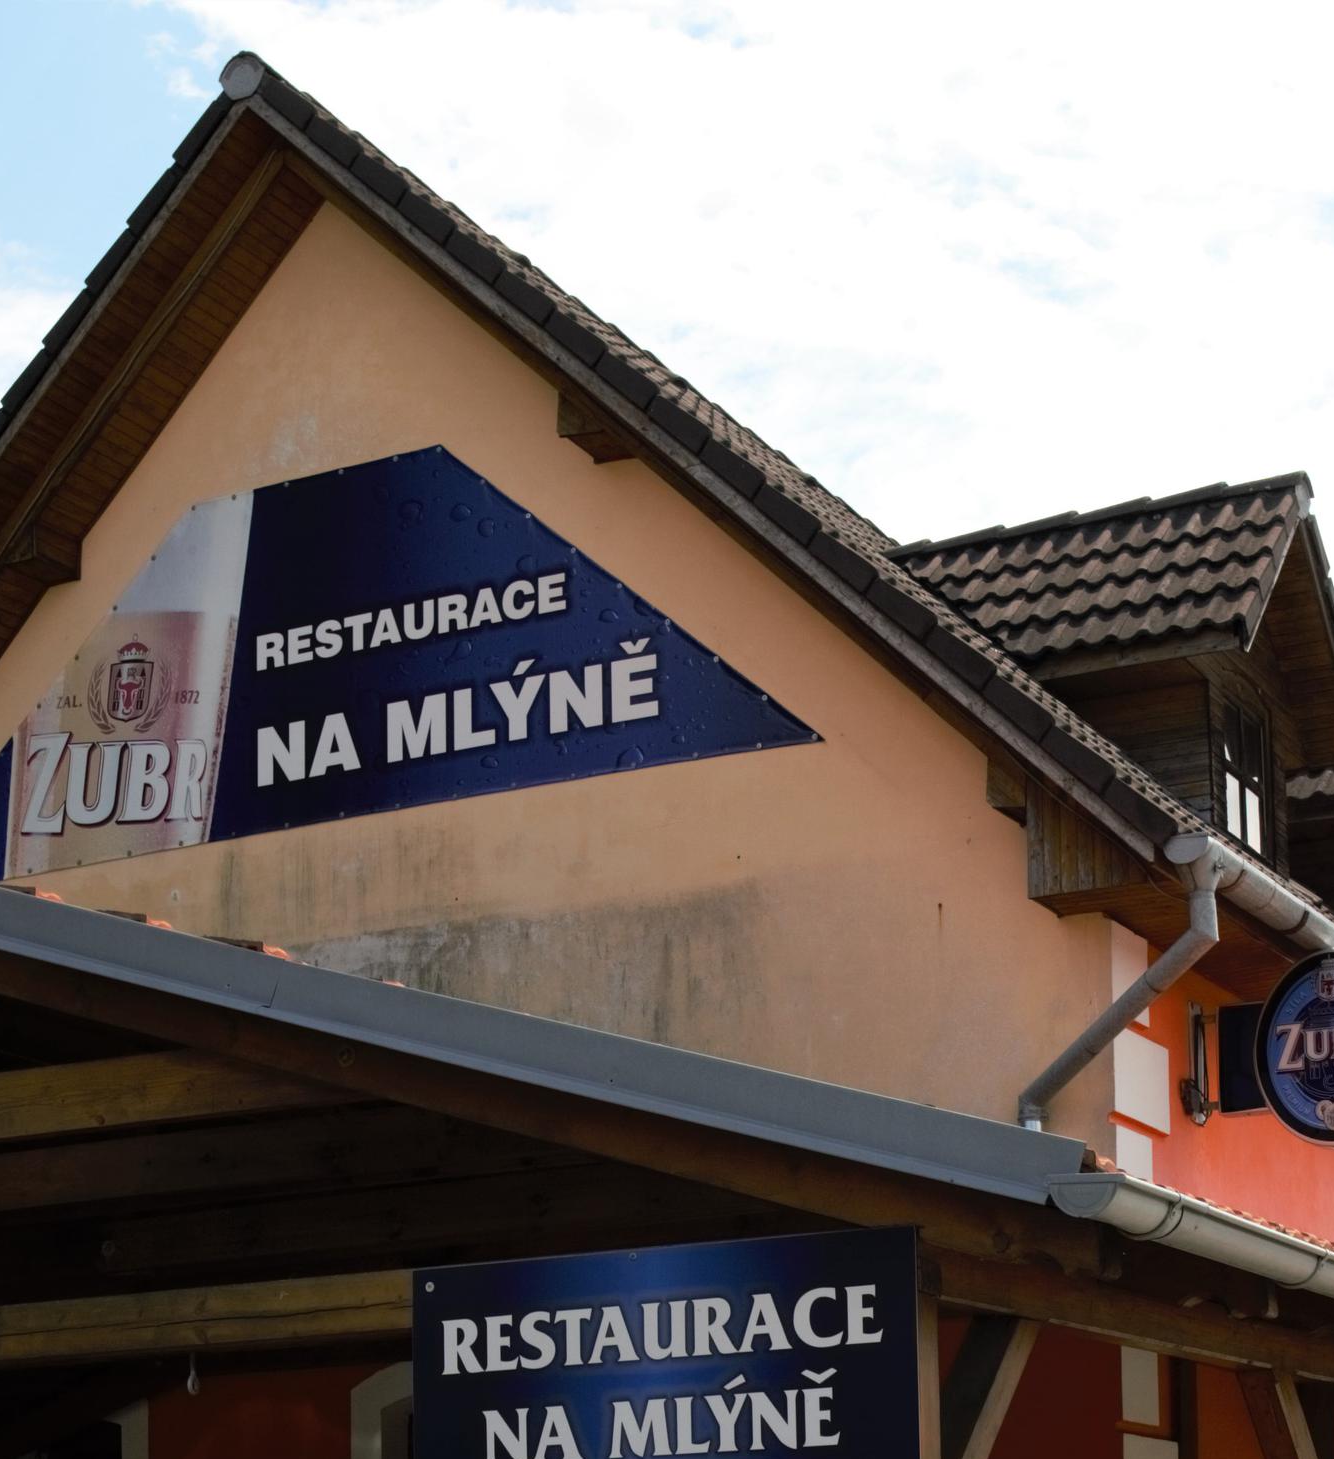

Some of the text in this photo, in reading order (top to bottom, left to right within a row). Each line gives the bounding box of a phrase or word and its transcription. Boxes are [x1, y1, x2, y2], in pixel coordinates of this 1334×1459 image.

[255, 571, 567, 672] RESTAURACE
[56, 689, 201, 711] ZAL. 1872
[255, 639, 660, 787] NA MLÝNĚ
[21, 731, 208, 836] ZUBR
[441, 1283, 884, 1376] RESTAURACE
[608, 1367, 841, 1459] MLÝNĚ
